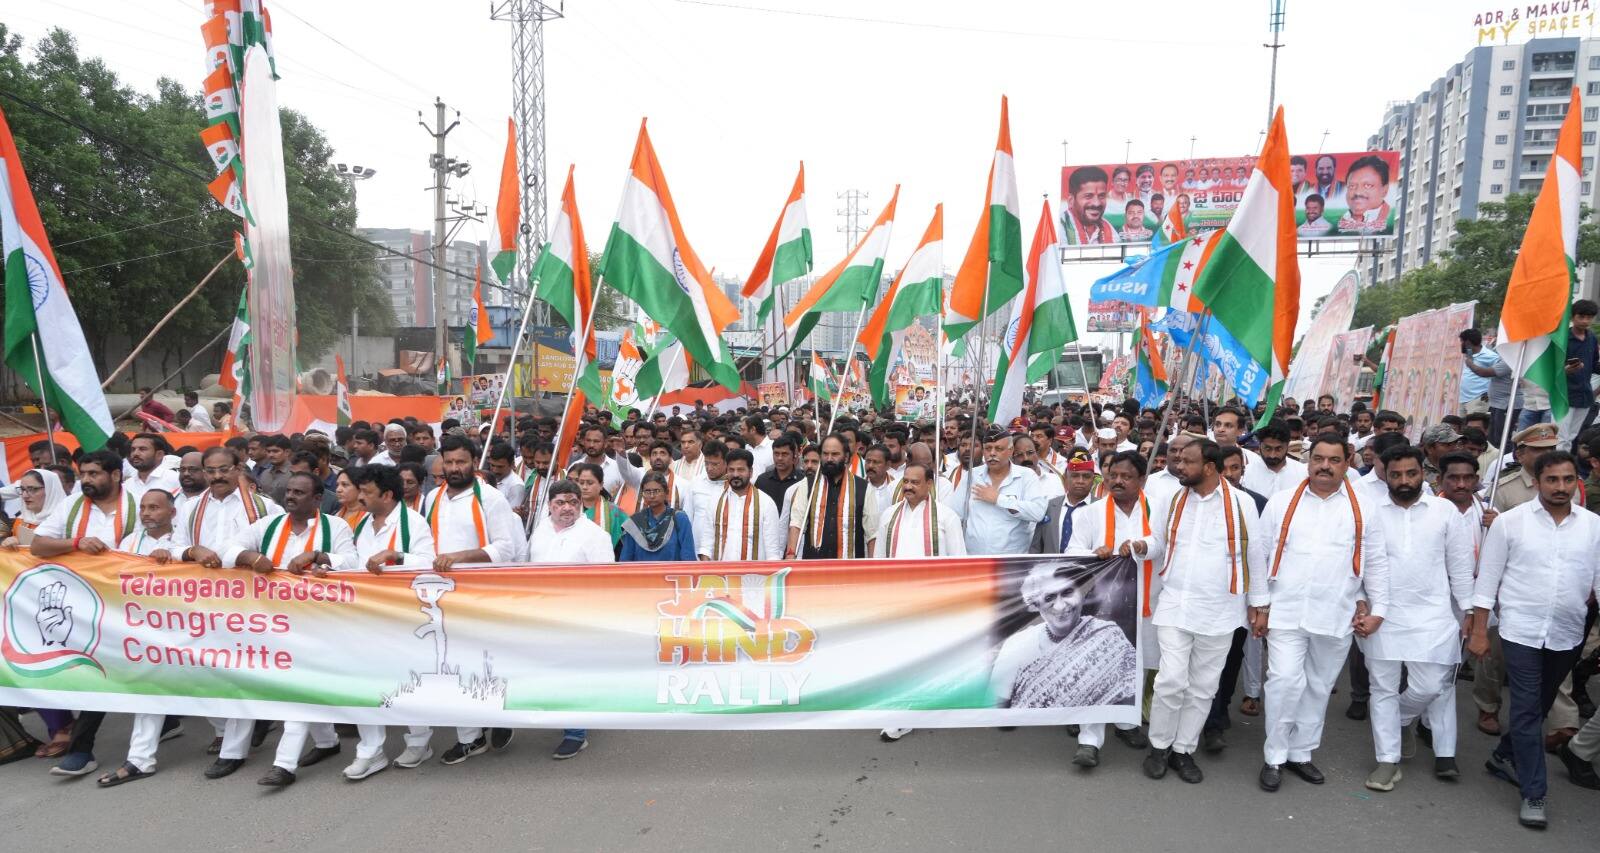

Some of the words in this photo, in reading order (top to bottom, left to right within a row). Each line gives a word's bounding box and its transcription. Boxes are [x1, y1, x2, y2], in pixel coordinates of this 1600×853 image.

[1474, 10, 1503, 26] ADR
[1511, 8, 1520, 21] &
[1526, 0, 1590, 19] MAKUTA
[1478, 20, 1519, 42] MY
[1528, 15, 1580, 34] SPACE
[119, 573, 246, 603] Telangana
[253, 576, 356, 603] Pradesh
[125, 603, 290, 638] Congress
[123, 636, 293, 670] Committe
[657, 617, 817, 665] HIND
[656, 670, 811, 706] RALLY
